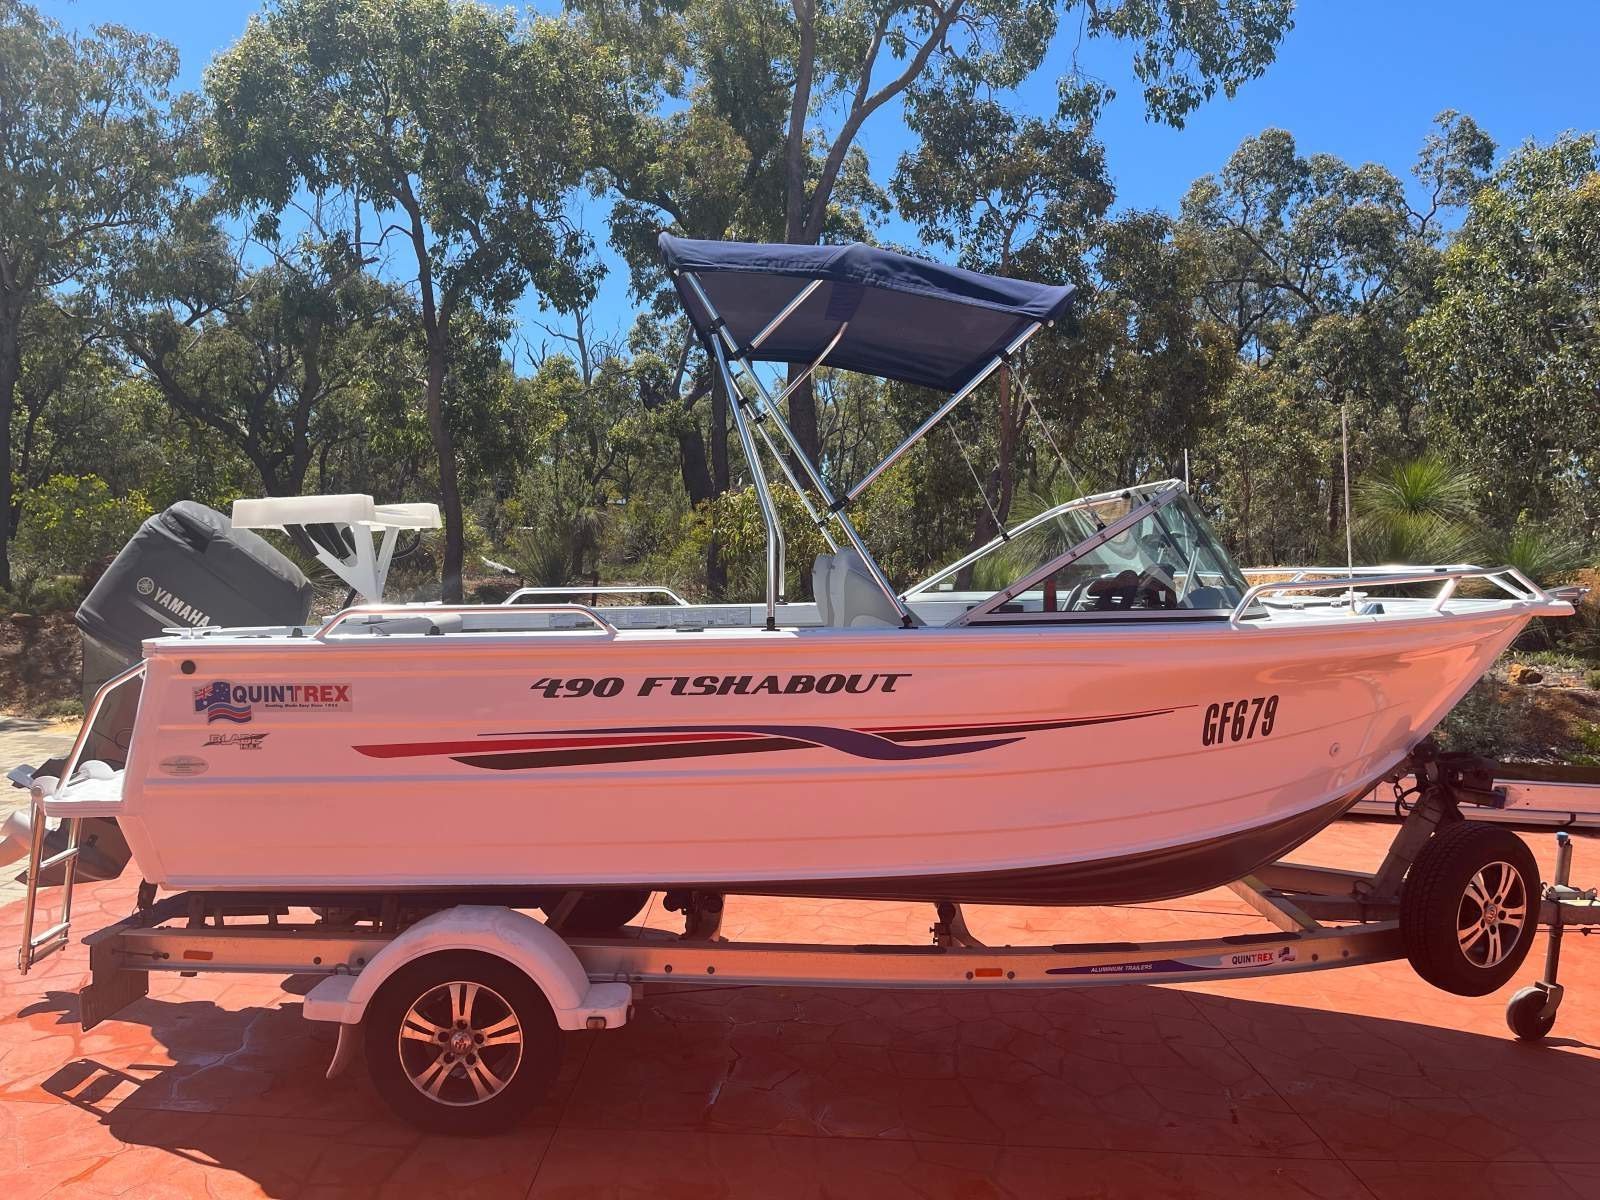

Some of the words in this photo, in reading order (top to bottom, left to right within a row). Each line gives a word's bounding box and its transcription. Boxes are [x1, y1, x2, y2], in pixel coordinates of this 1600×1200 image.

[153, 586, 211, 627] YAMAHA
[232, 685, 350, 704] QUINTREX
[530, 677, 624, 698] 490
[637, 674, 912, 696] FISHABOUT
[1202, 695, 1279, 746] GF679
[1231, 952, 1274, 965] QUINTREX
